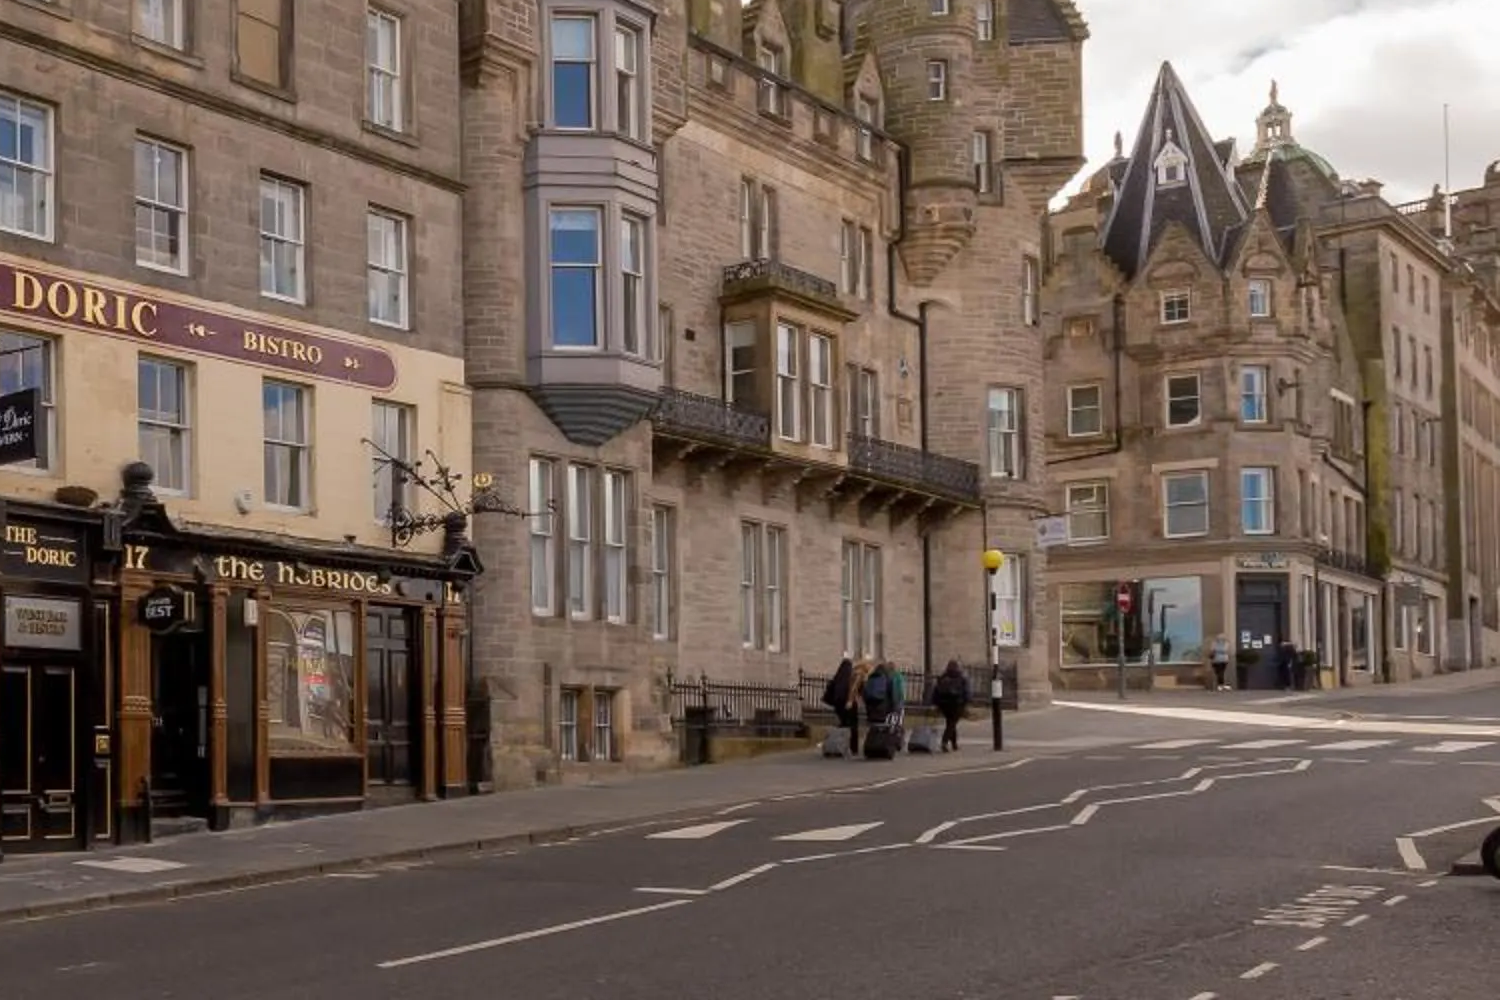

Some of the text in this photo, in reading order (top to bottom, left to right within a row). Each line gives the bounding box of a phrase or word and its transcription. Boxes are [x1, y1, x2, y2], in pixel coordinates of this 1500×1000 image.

[12, 271, 159, 338] DORIC
[243, 330, 323, 366] BISTRO
[5, 525, 37, 545] THE
[26, 546, 76, 567] DORIC
[125, 544, 149, 569] 17
